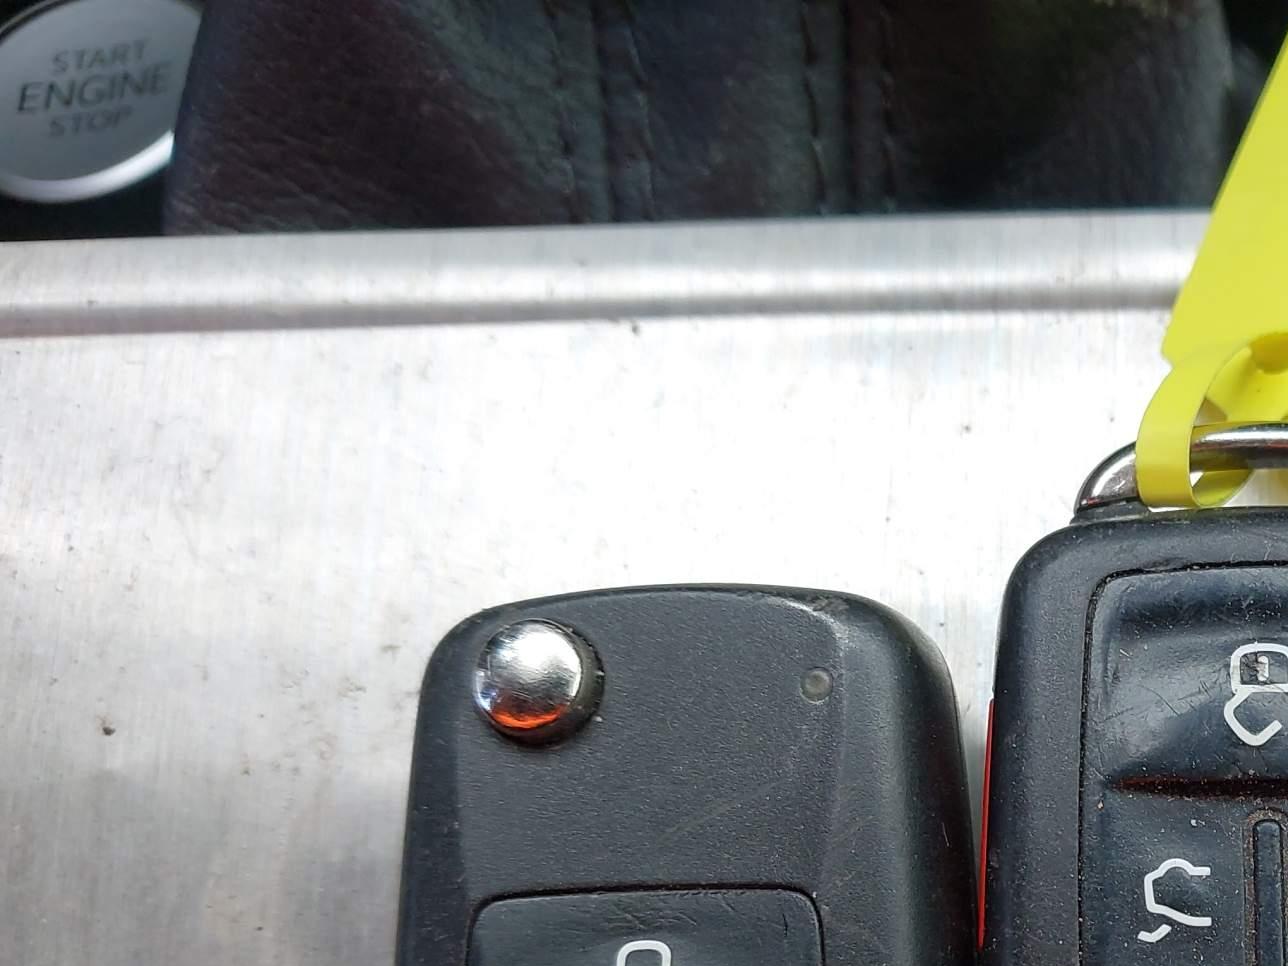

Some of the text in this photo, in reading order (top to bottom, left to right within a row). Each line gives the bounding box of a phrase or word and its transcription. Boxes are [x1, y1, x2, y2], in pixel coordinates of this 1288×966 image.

[52, 40, 147, 75] START
[17, 62, 173, 114] ENGINE
[48, 105, 133, 138] STOP
